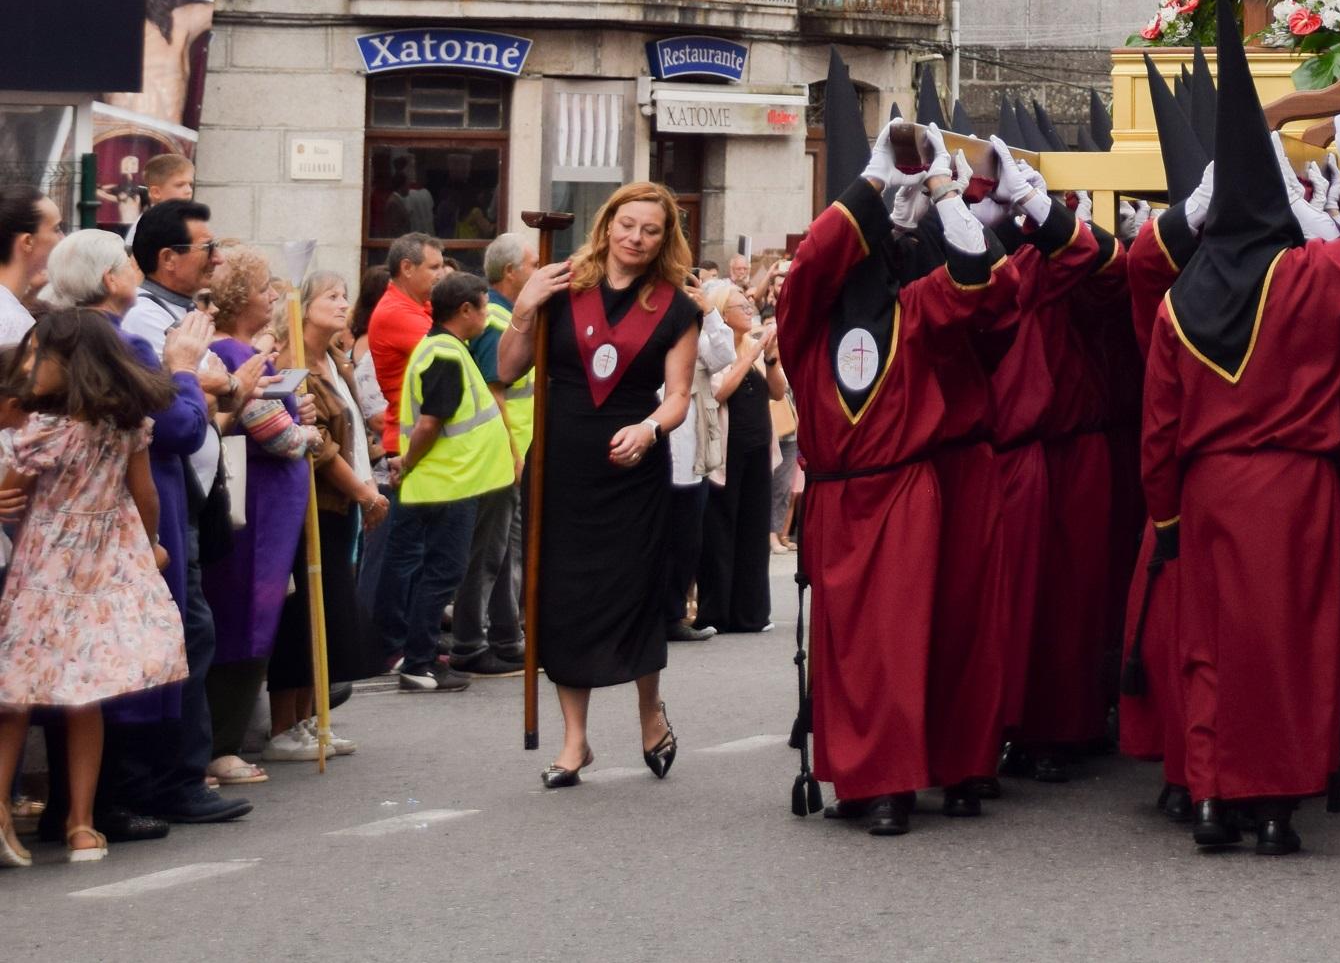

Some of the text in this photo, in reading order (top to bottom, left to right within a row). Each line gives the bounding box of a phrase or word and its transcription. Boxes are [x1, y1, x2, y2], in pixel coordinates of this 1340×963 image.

[369, 33, 520, 69] Xatomé
[663, 45, 744, 71] Restaurante
[666, 106, 732, 127] XATOME
